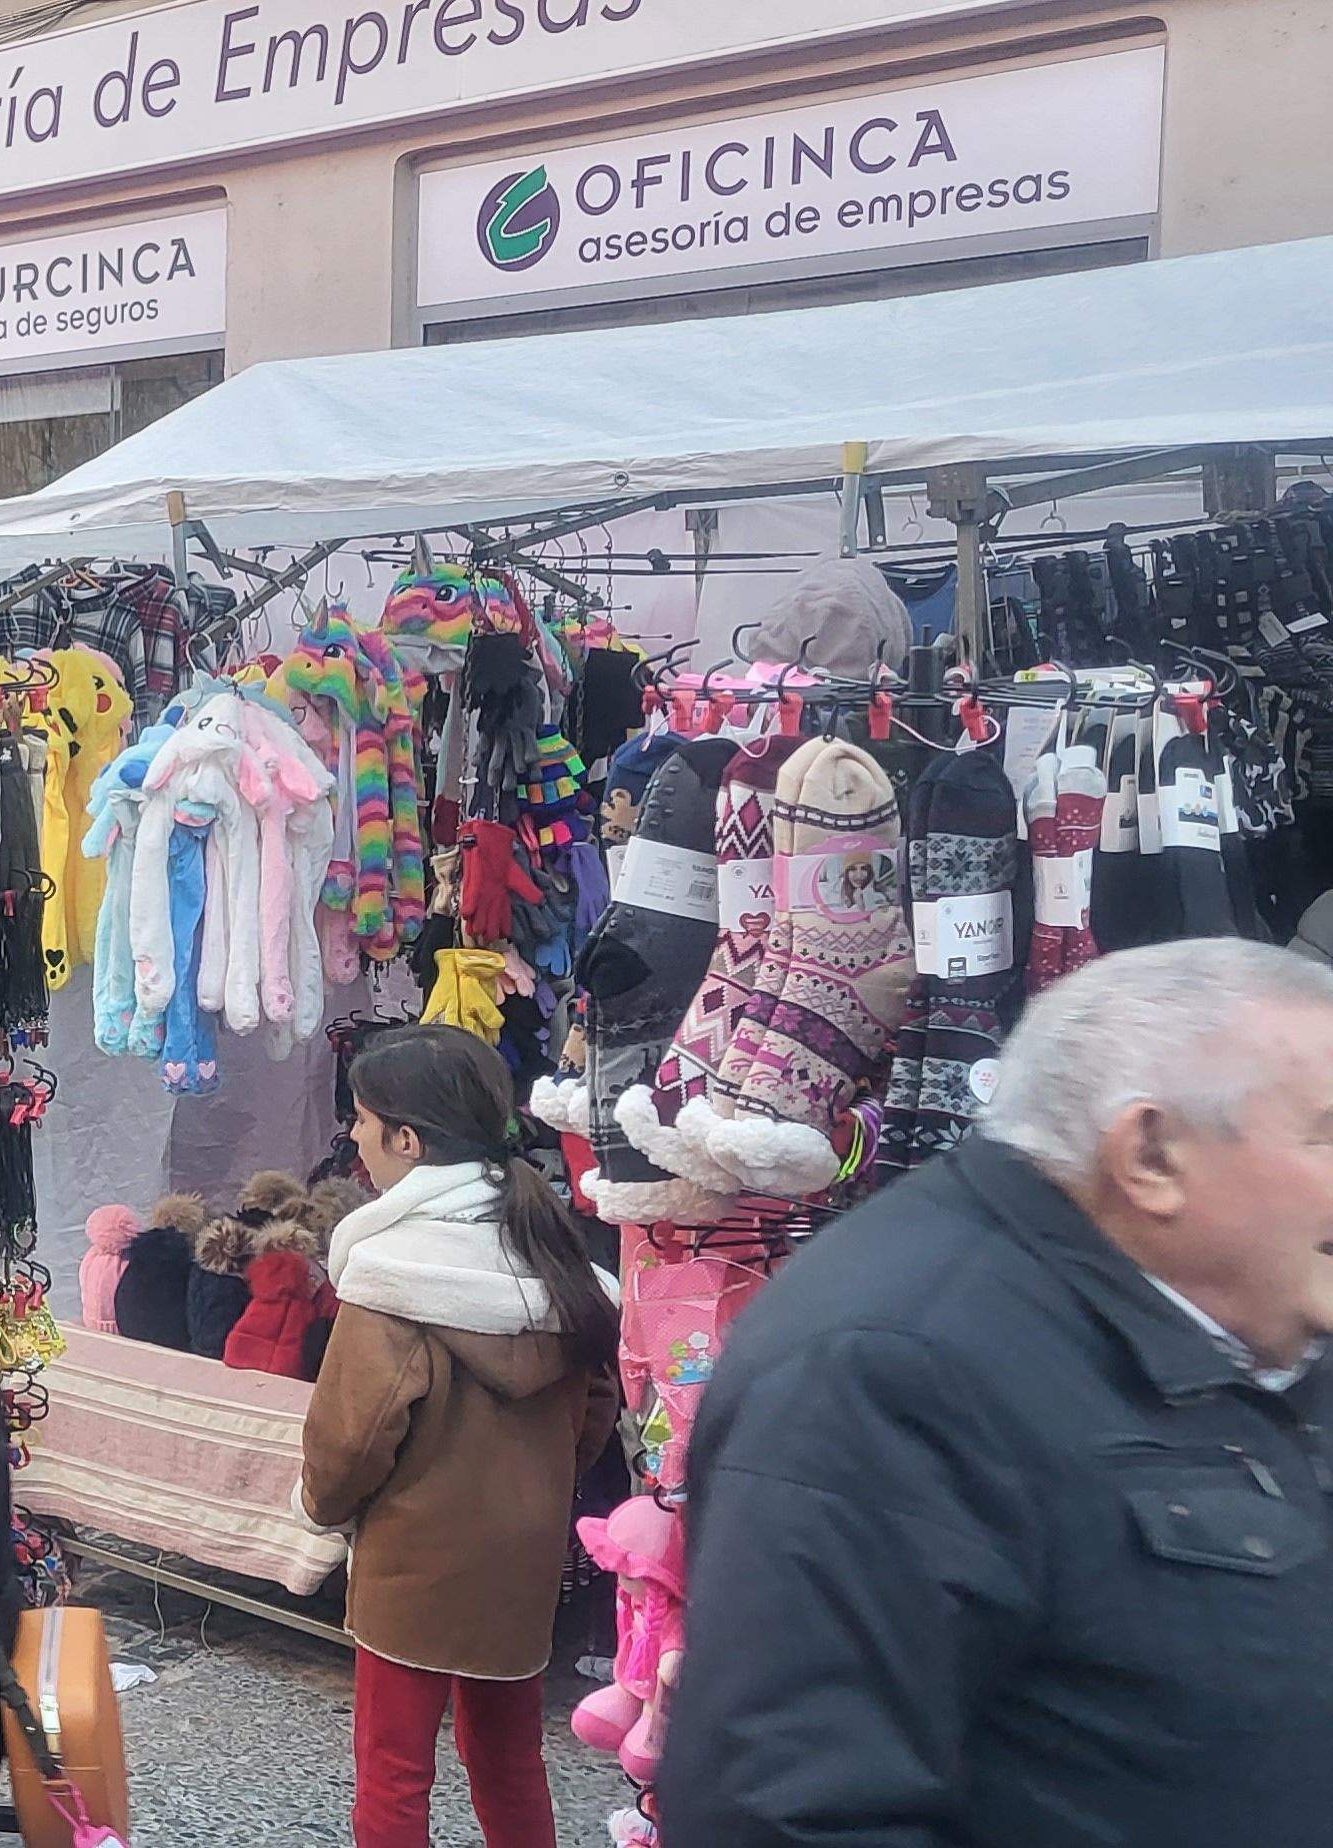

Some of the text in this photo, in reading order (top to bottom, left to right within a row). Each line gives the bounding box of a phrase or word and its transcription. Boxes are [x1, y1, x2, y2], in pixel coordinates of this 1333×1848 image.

[93, 31, 181, 128] de
[574, 108, 958, 216] OFICINCA
[577, 166, 1072, 265] asesoría de empresas
[15, 307, 48, 338] de
[55, 296, 160, 339] seguros
